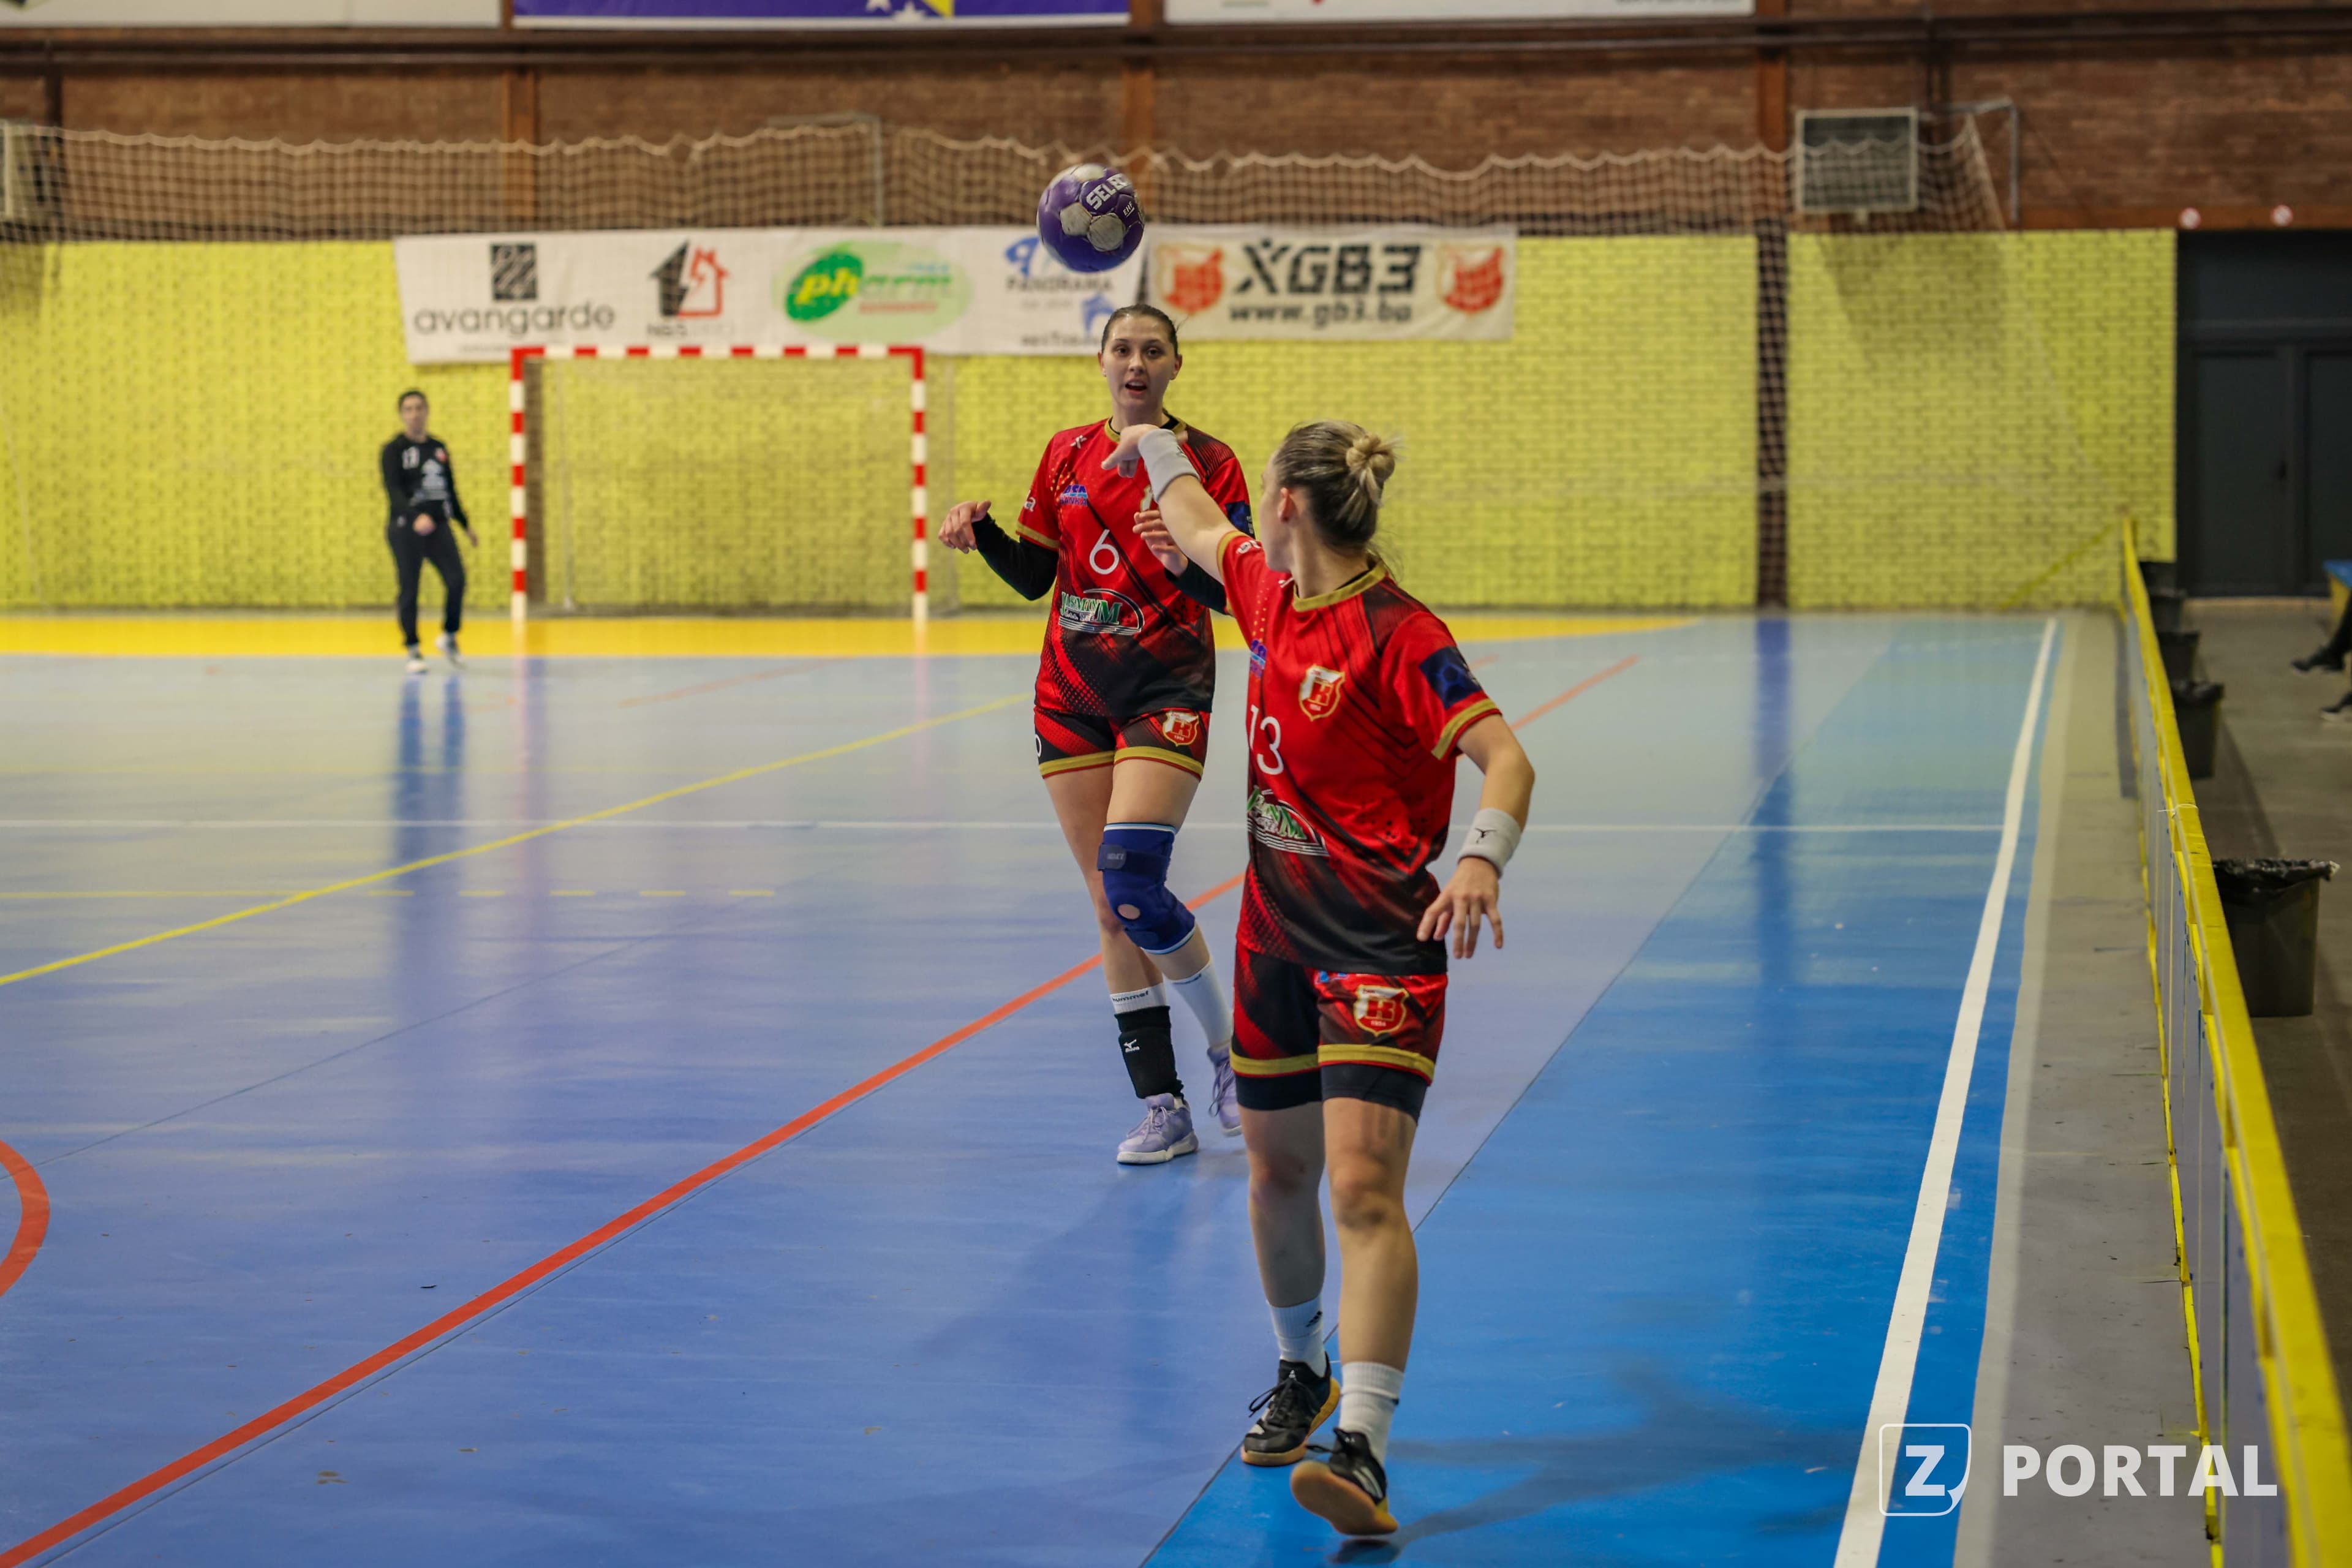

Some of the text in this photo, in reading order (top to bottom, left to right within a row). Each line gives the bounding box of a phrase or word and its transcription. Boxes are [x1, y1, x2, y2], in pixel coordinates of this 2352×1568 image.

[413, 301, 616, 339] avangarde
[1229, 297, 1412, 330] www.gb3.ba
[1089, 529, 1120, 575] 6
[1250, 704, 1284, 775] 13
[1112, 990, 1148, 1002] hummel
